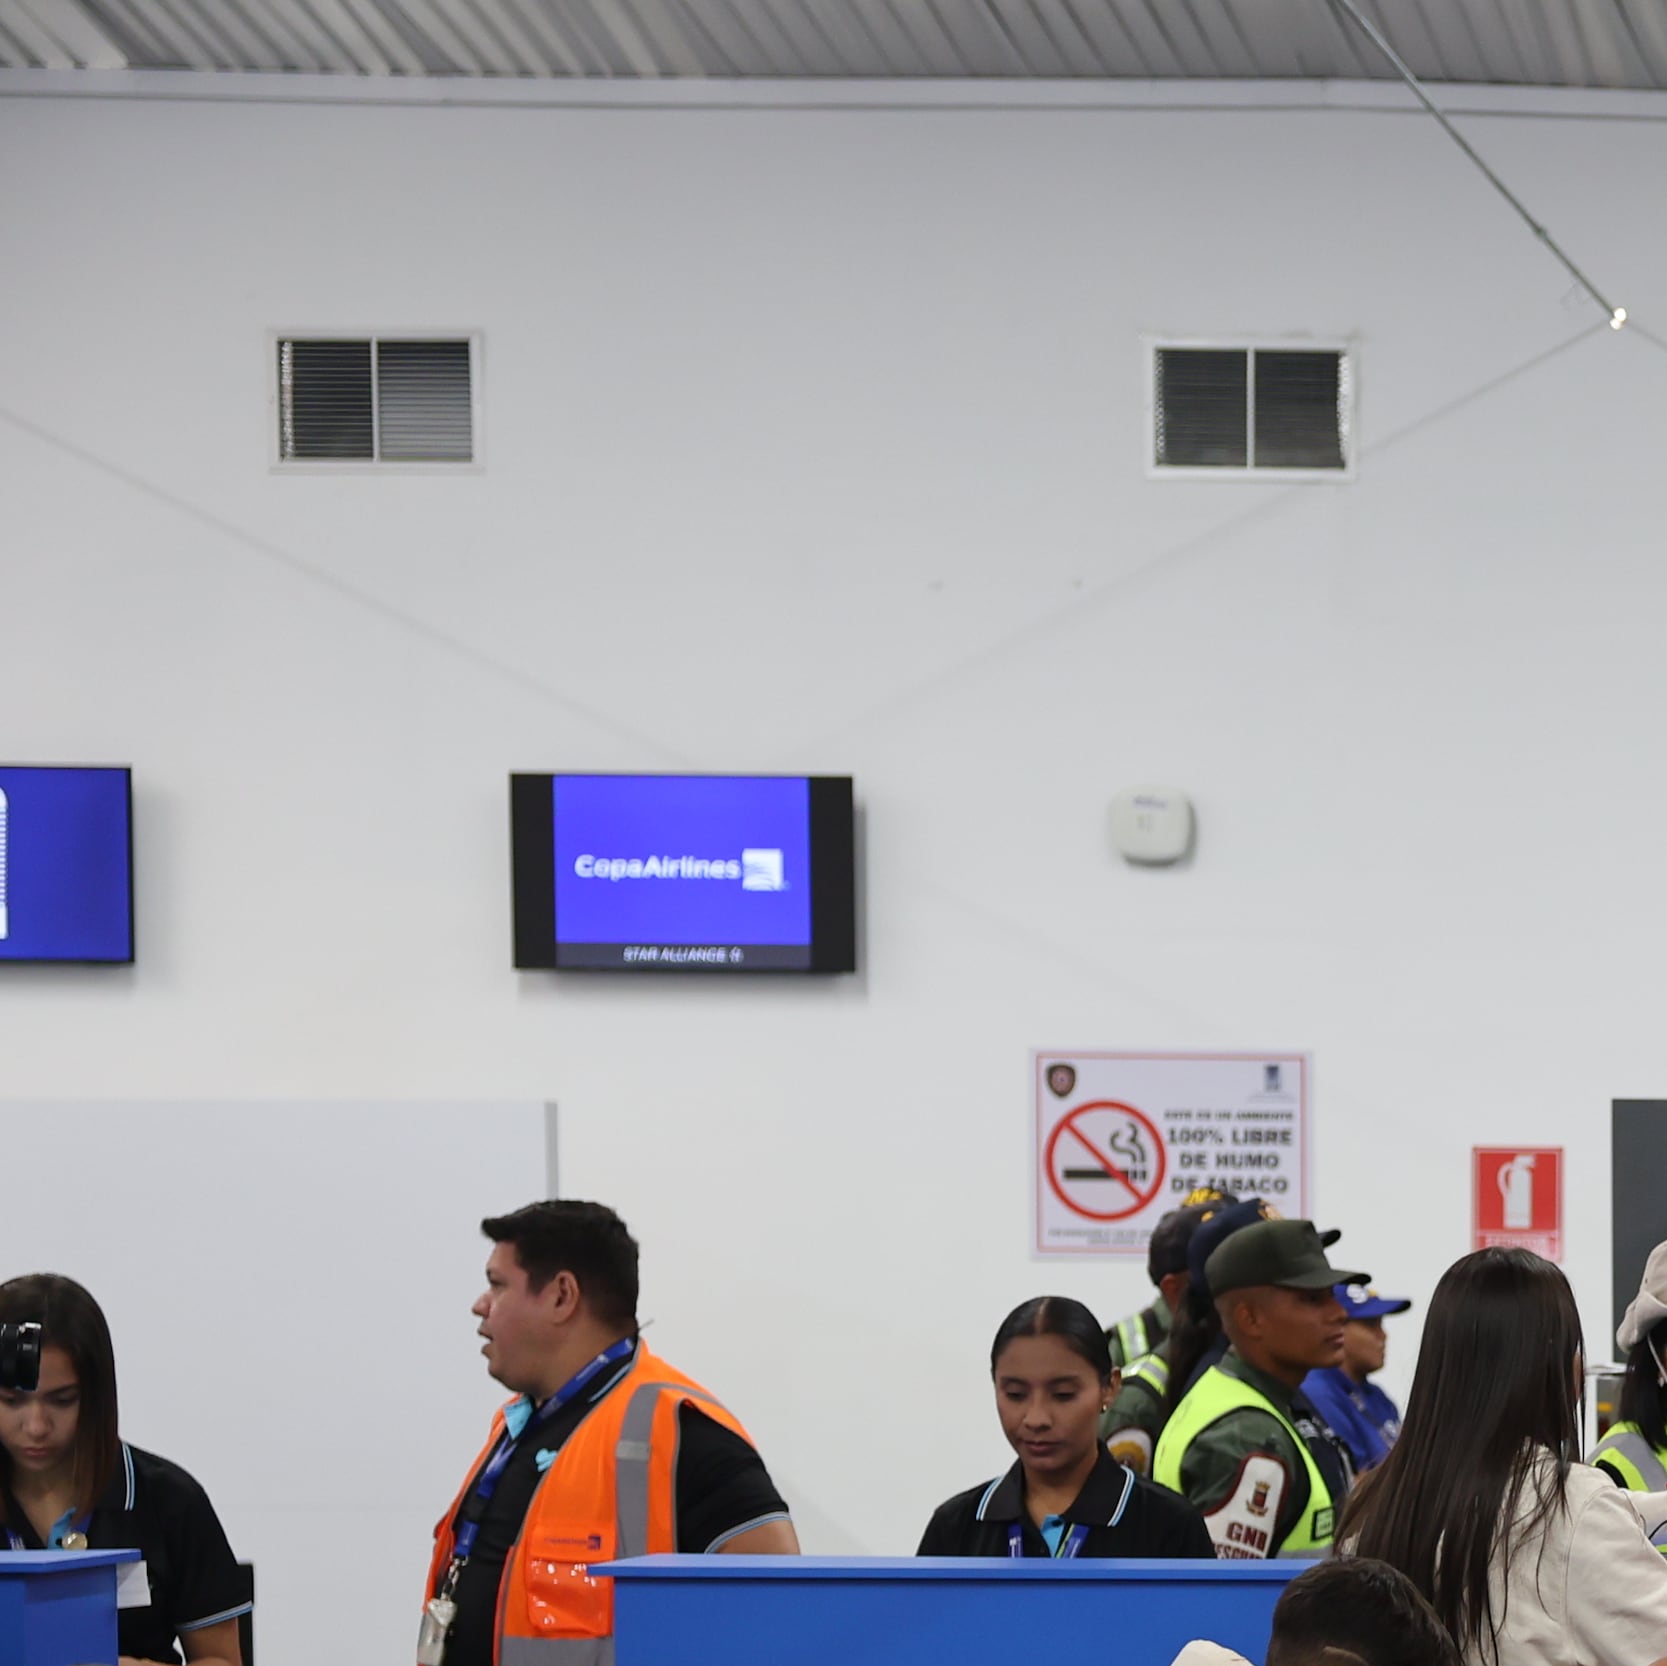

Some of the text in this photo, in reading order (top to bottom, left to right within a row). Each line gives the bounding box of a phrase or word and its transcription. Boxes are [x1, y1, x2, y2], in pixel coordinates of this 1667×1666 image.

[574, 854, 741, 881] CopaAirlines
[1169, 1128, 1292, 1146] 100% LIBRE
[1180, 1153, 1279, 1169] DE HUMO
